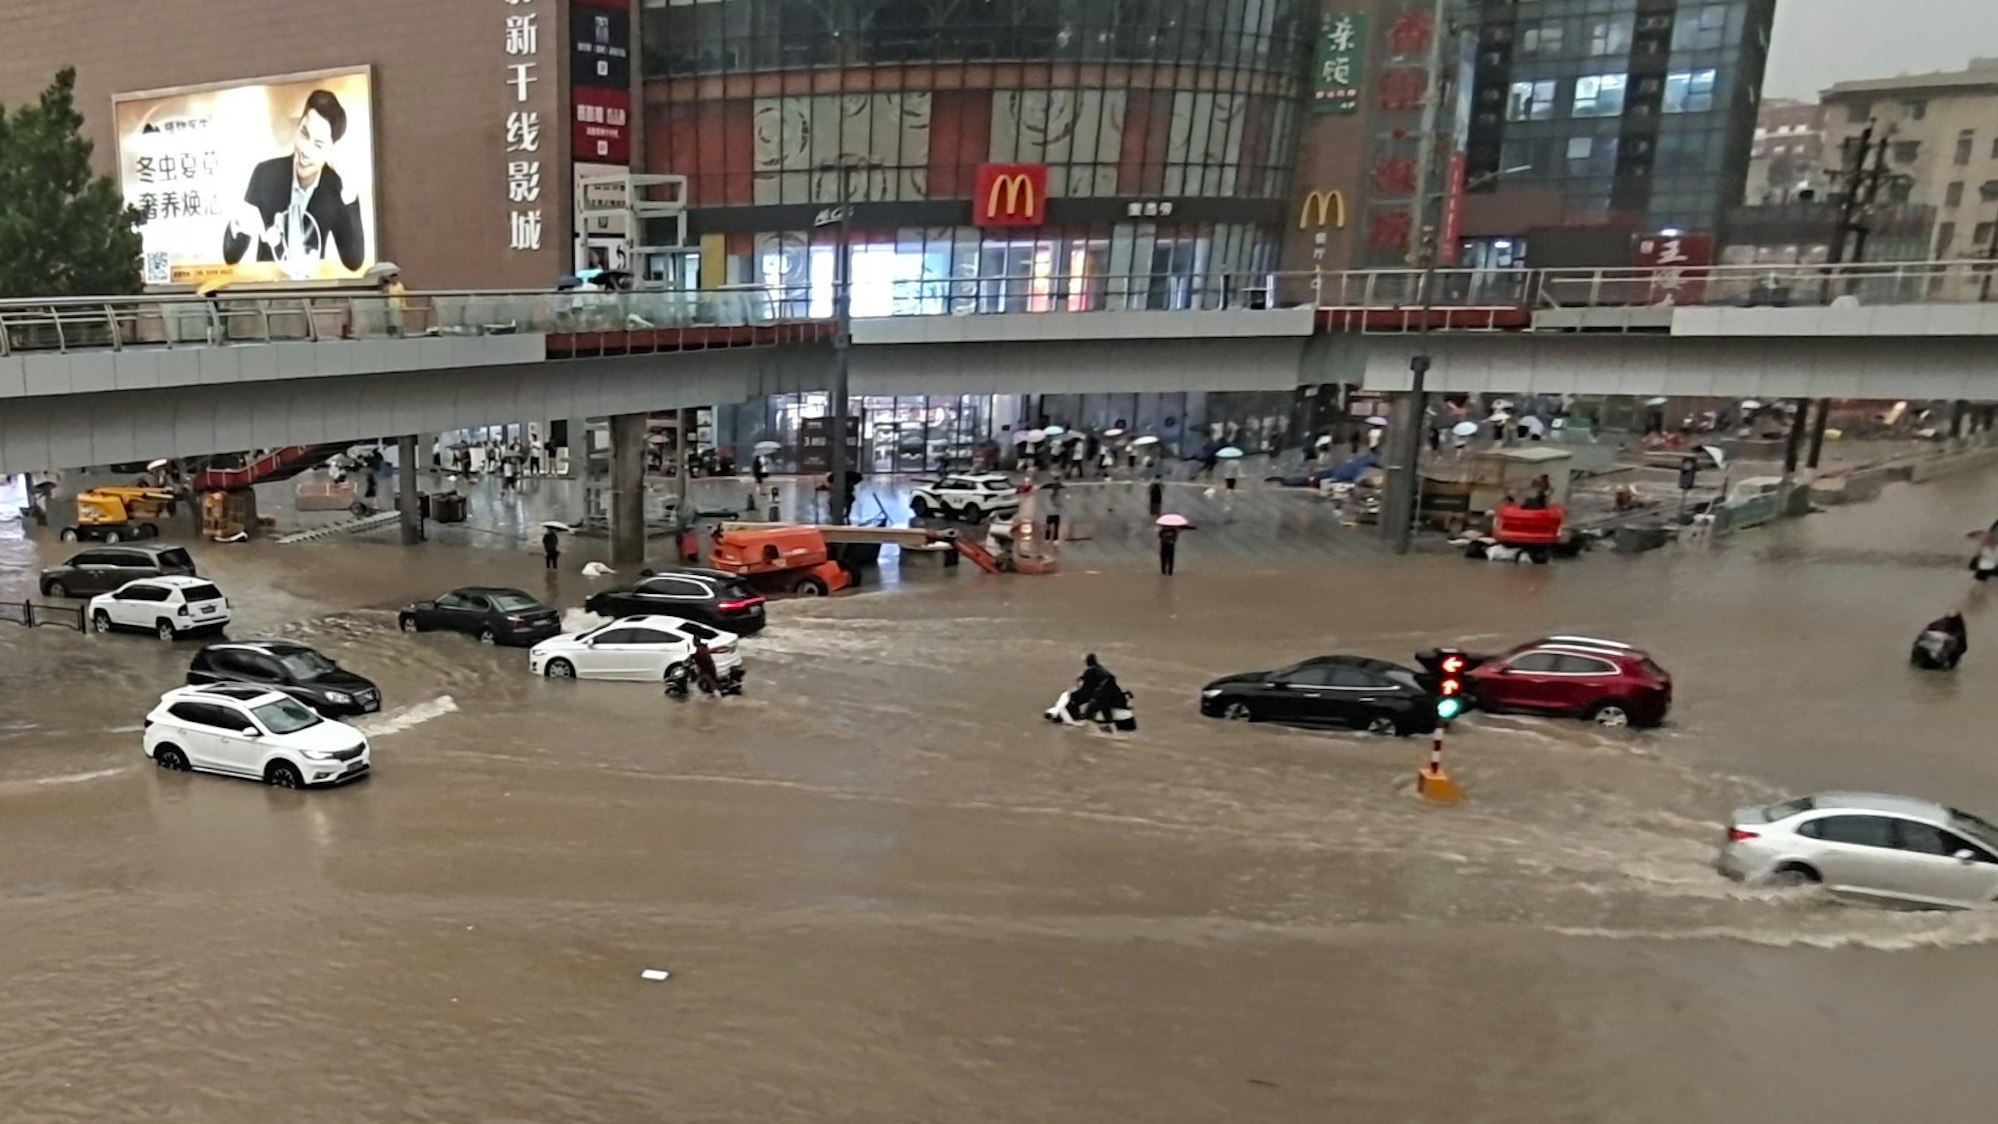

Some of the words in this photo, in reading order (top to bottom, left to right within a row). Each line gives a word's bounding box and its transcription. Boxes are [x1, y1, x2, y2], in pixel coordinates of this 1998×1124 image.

[505, 0, 542, 250] 新干线影城
